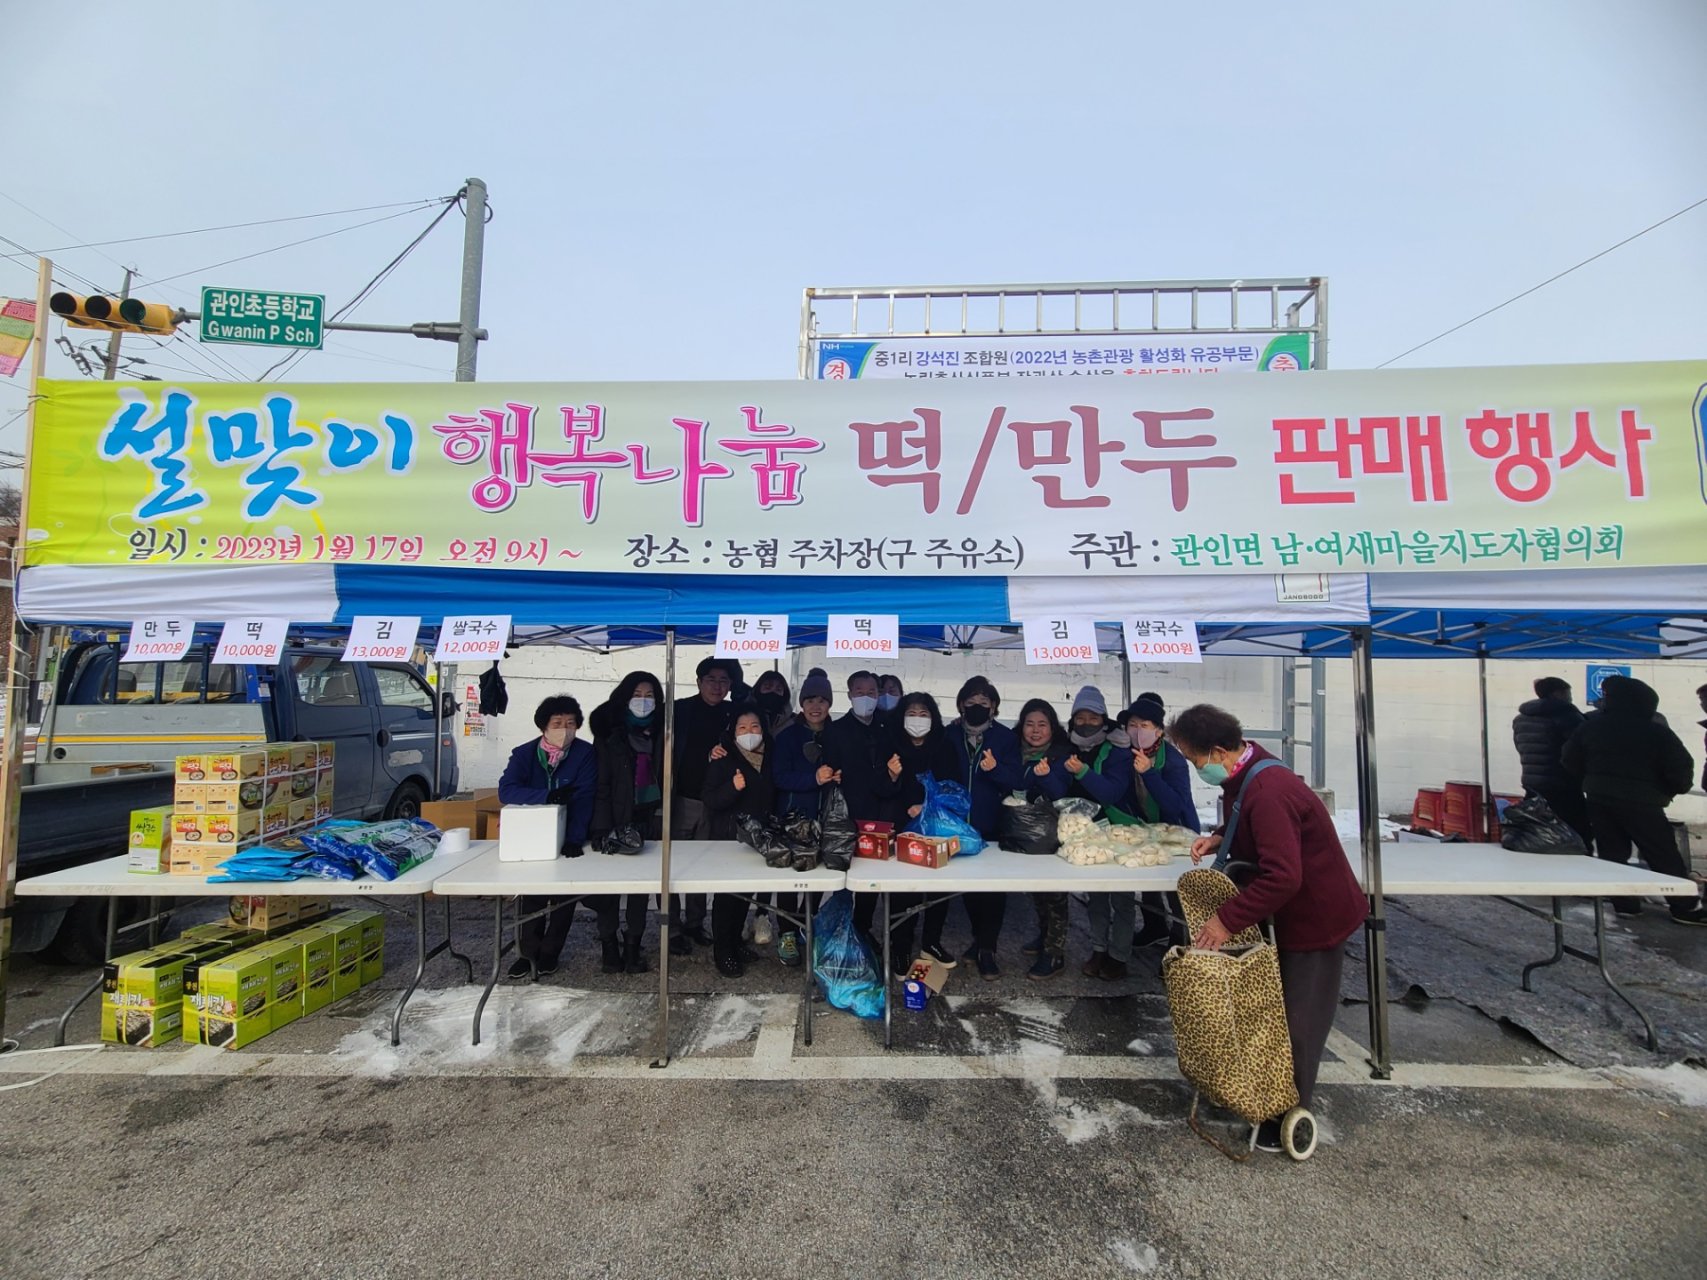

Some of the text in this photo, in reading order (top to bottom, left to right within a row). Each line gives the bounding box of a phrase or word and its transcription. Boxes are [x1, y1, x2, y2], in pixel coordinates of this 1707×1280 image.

[210, 291, 315, 321] 관인초등학교
[208, 320, 314, 343] Gwanin P Sch
[875, 350, 912, 366] 중1리
[916, 350, 959, 366] 강석진
[1072, 348, 1134, 365] 농촌관광
[1139, 347, 1186, 364] 활성화
[1190, 346, 1259, 363] 유공부문)
[104, 391, 414, 519] 설맞이
[432, 403, 826, 527] 행복나눔
[849, 406, 1237, 515] 떡/만두
[212, 535, 301, 562] 2023년
[310, 535, 355, 561] 1월
[361, 535, 424, 561] 17일
[439, 537, 497, 563] 오전
[503, 537, 548, 565] 9시
[722, 539, 779, 569] 농협
[1170, 533, 1263, 567] 관인면
[246, 621, 263, 640] 떡
[376, 621, 394, 640] 김
[452, 619, 499, 637] 쌀국수
[853, 618, 872, 638] 떡
[1050, 619, 1069, 640] 김
[1134, 619, 1184, 637] 쌀국수
[133, 642, 186, 656] 10,000원
[221, 643, 277, 659] 10,000원
[350, 645, 408, 660] 13,000원
[442, 640, 502, 655] 12,000원
[722, 639, 781, 654] 10,000원
[833, 638, 892, 654] 10,000원
[1033, 645, 1093, 661] 13,000원
[1133, 642, 1195, 656] 12,000원
